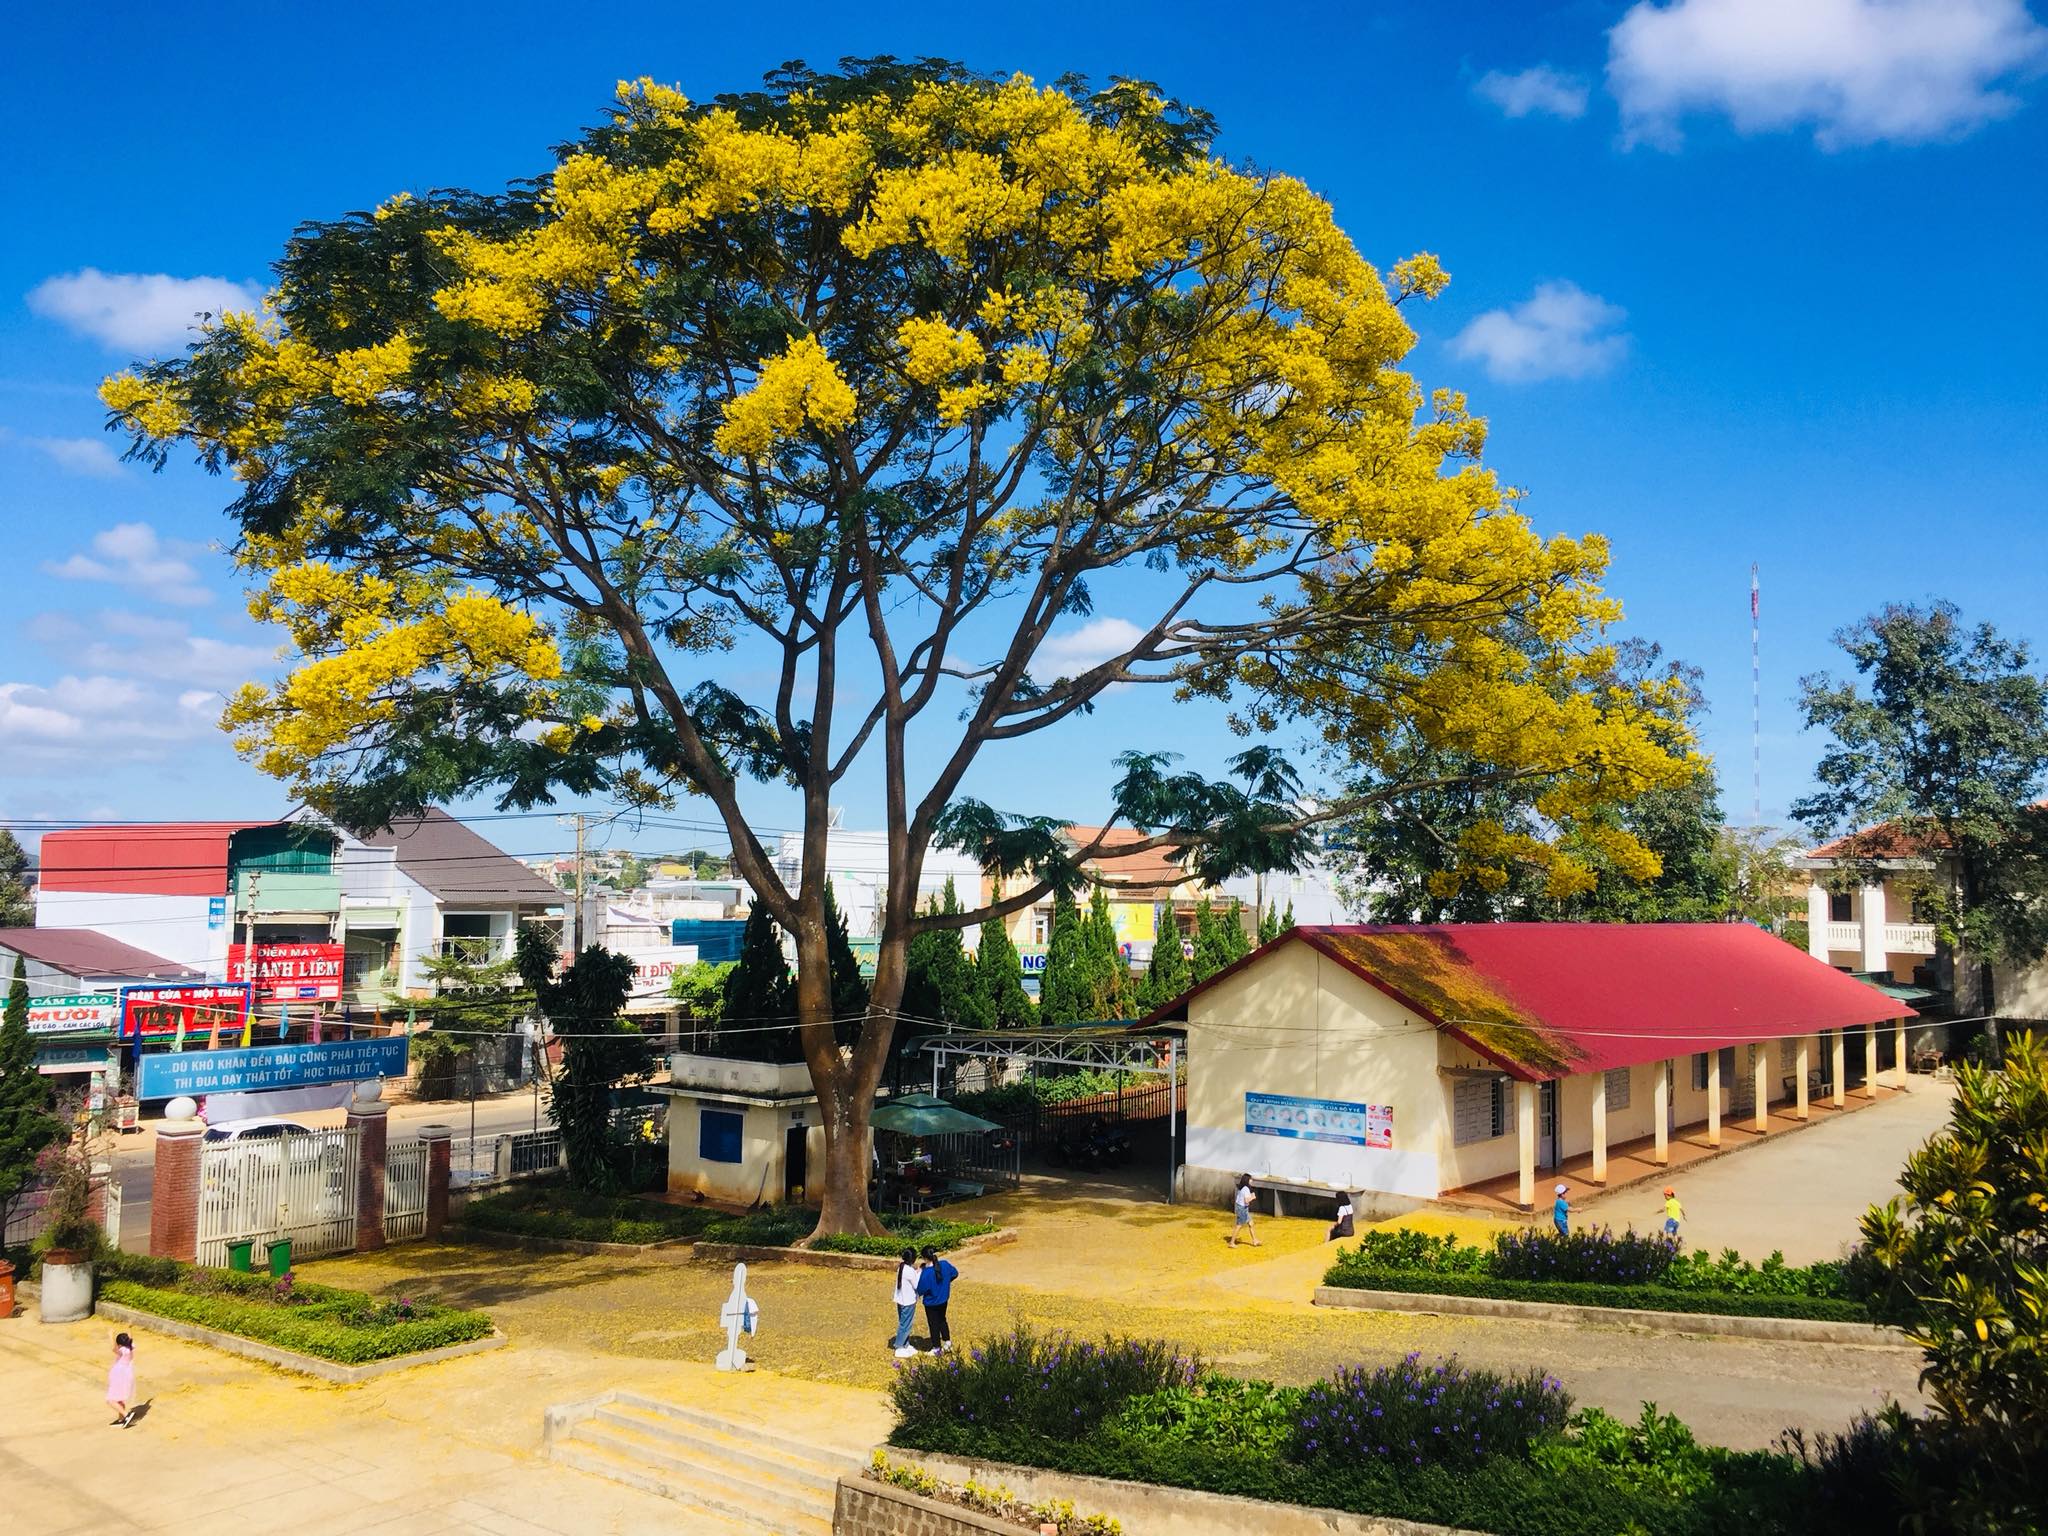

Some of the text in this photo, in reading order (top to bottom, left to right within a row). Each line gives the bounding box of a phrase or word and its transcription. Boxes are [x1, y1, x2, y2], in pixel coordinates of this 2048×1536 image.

[233, 961, 294, 978] THANH
[381, 1045, 399, 1057] TỤC
[174, 1078, 192, 1089] THI
[196, 1076, 218, 1088] ĐUA
[221, 1073, 242, 1087] DẠY
[274, 1066, 293, 1081] TỐT
[303, 1066, 325, 1079] HỌC
